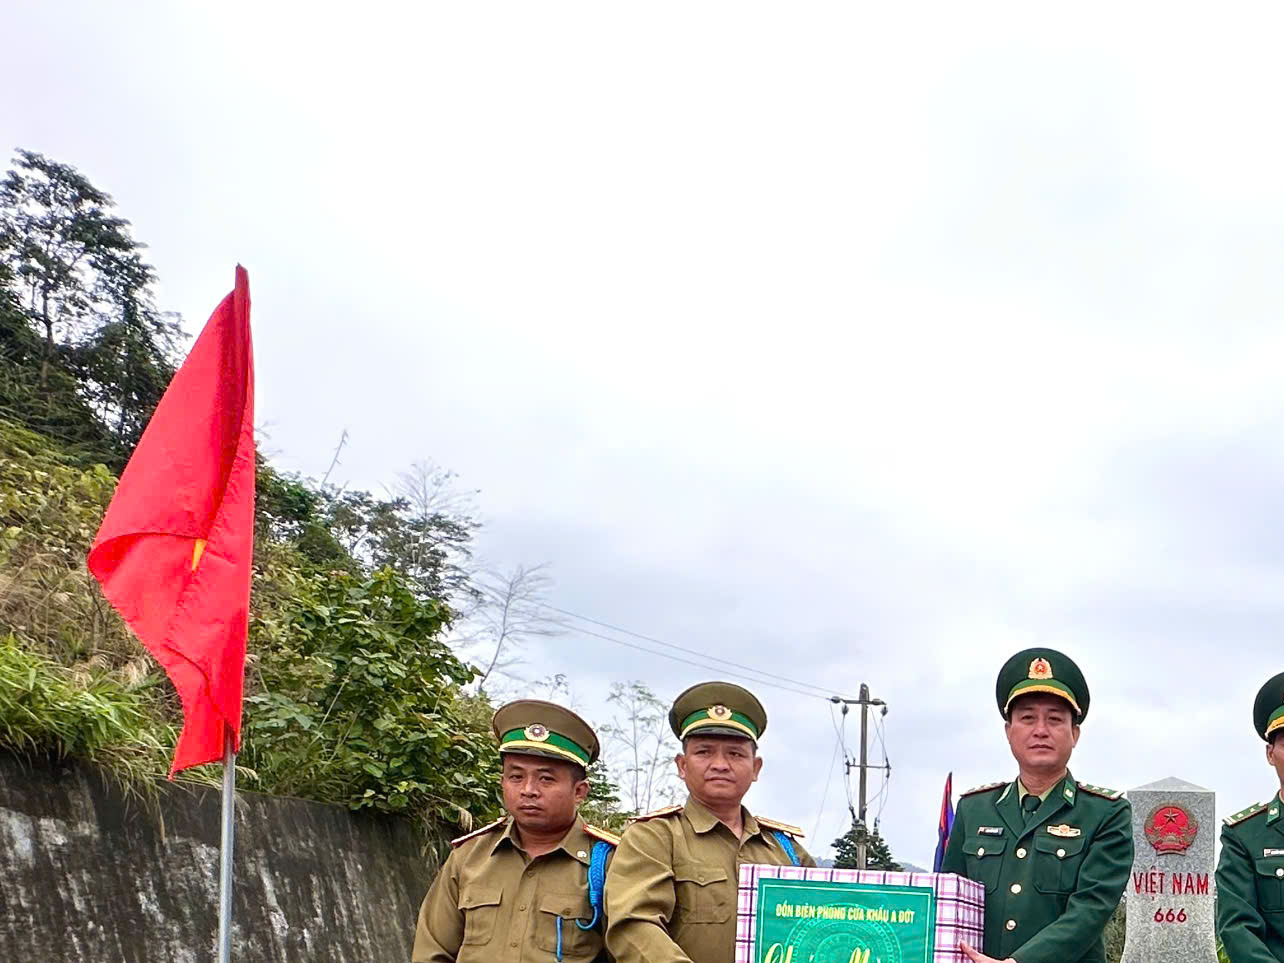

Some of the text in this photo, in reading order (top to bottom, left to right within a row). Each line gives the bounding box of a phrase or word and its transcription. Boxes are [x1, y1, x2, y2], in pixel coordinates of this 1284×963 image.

[1133, 866, 1209, 901] VIỆT NAM
[890, 909, 897, 922] A
[1153, 908, 1187, 923] 666
